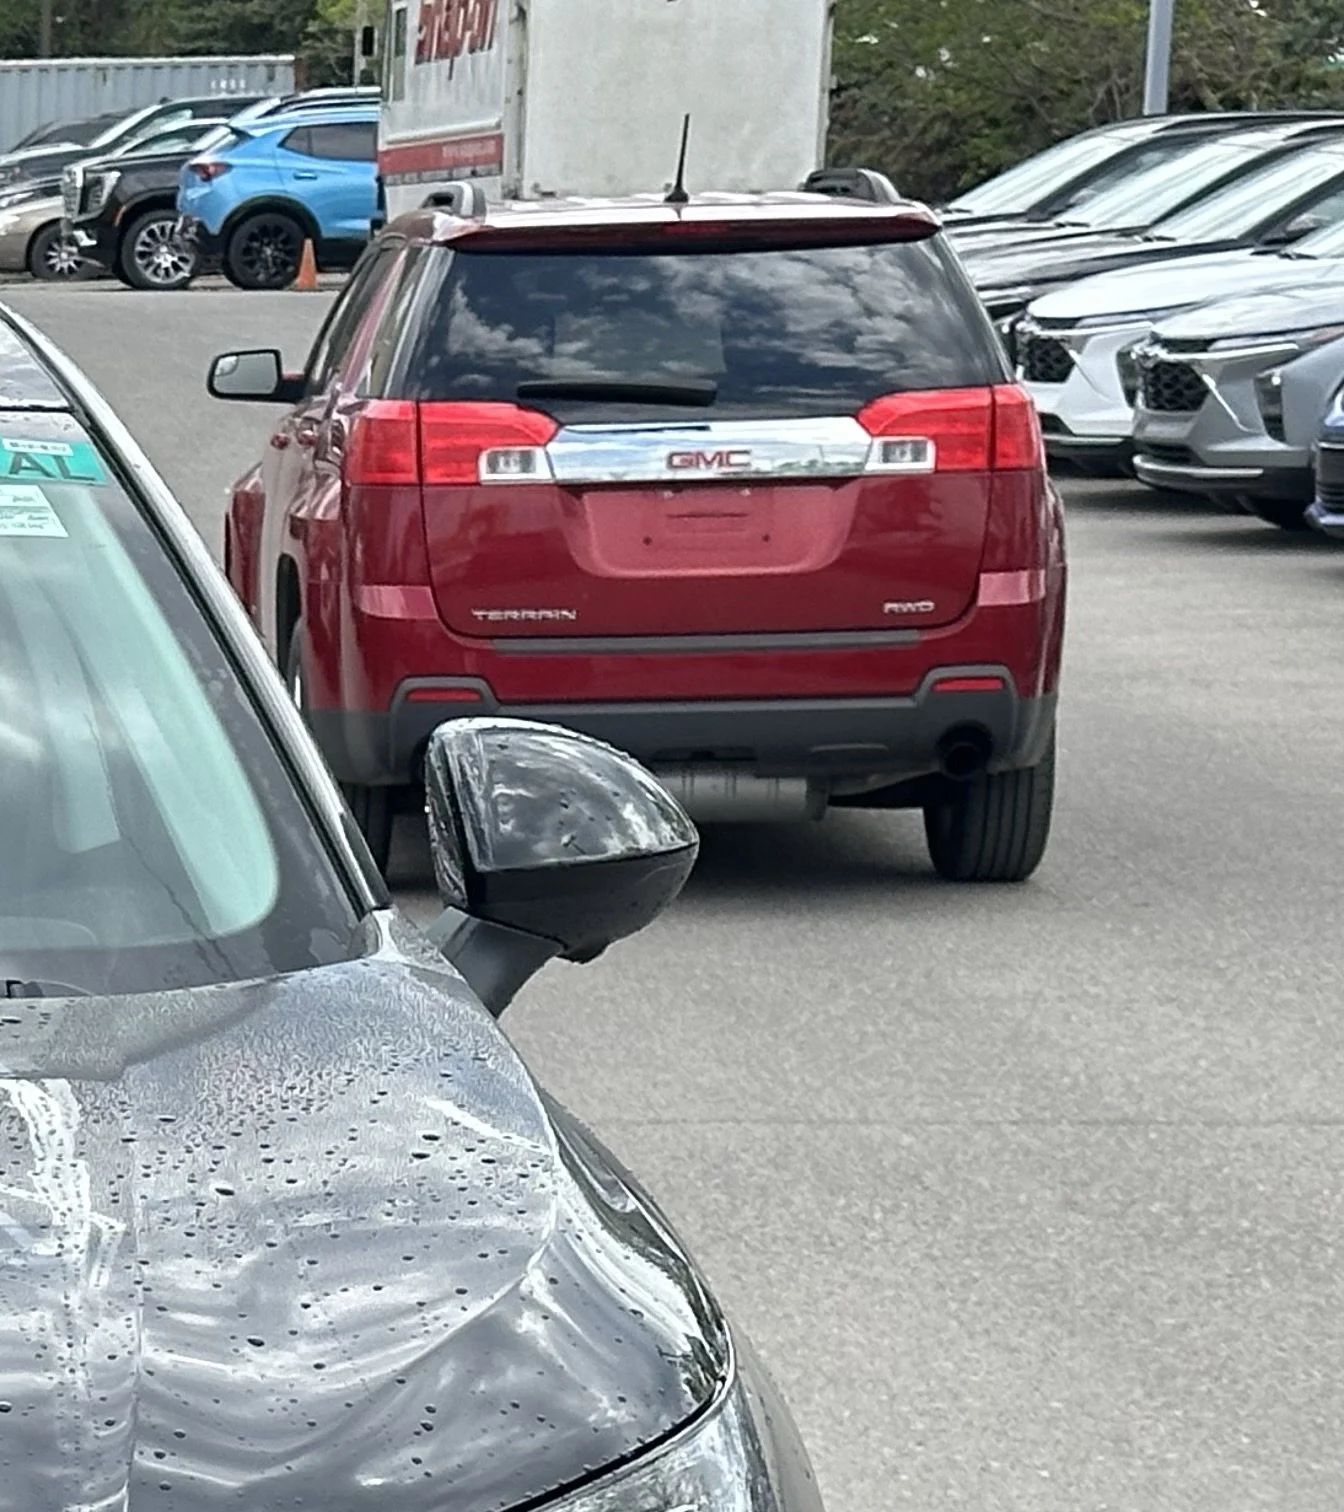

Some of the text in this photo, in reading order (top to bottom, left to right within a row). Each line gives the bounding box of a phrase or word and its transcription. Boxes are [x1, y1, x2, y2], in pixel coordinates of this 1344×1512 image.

[667, 450, 751, 469] GMC
[883, 602, 935, 613] AWD
[471, 609, 576, 620] TERRAIN
